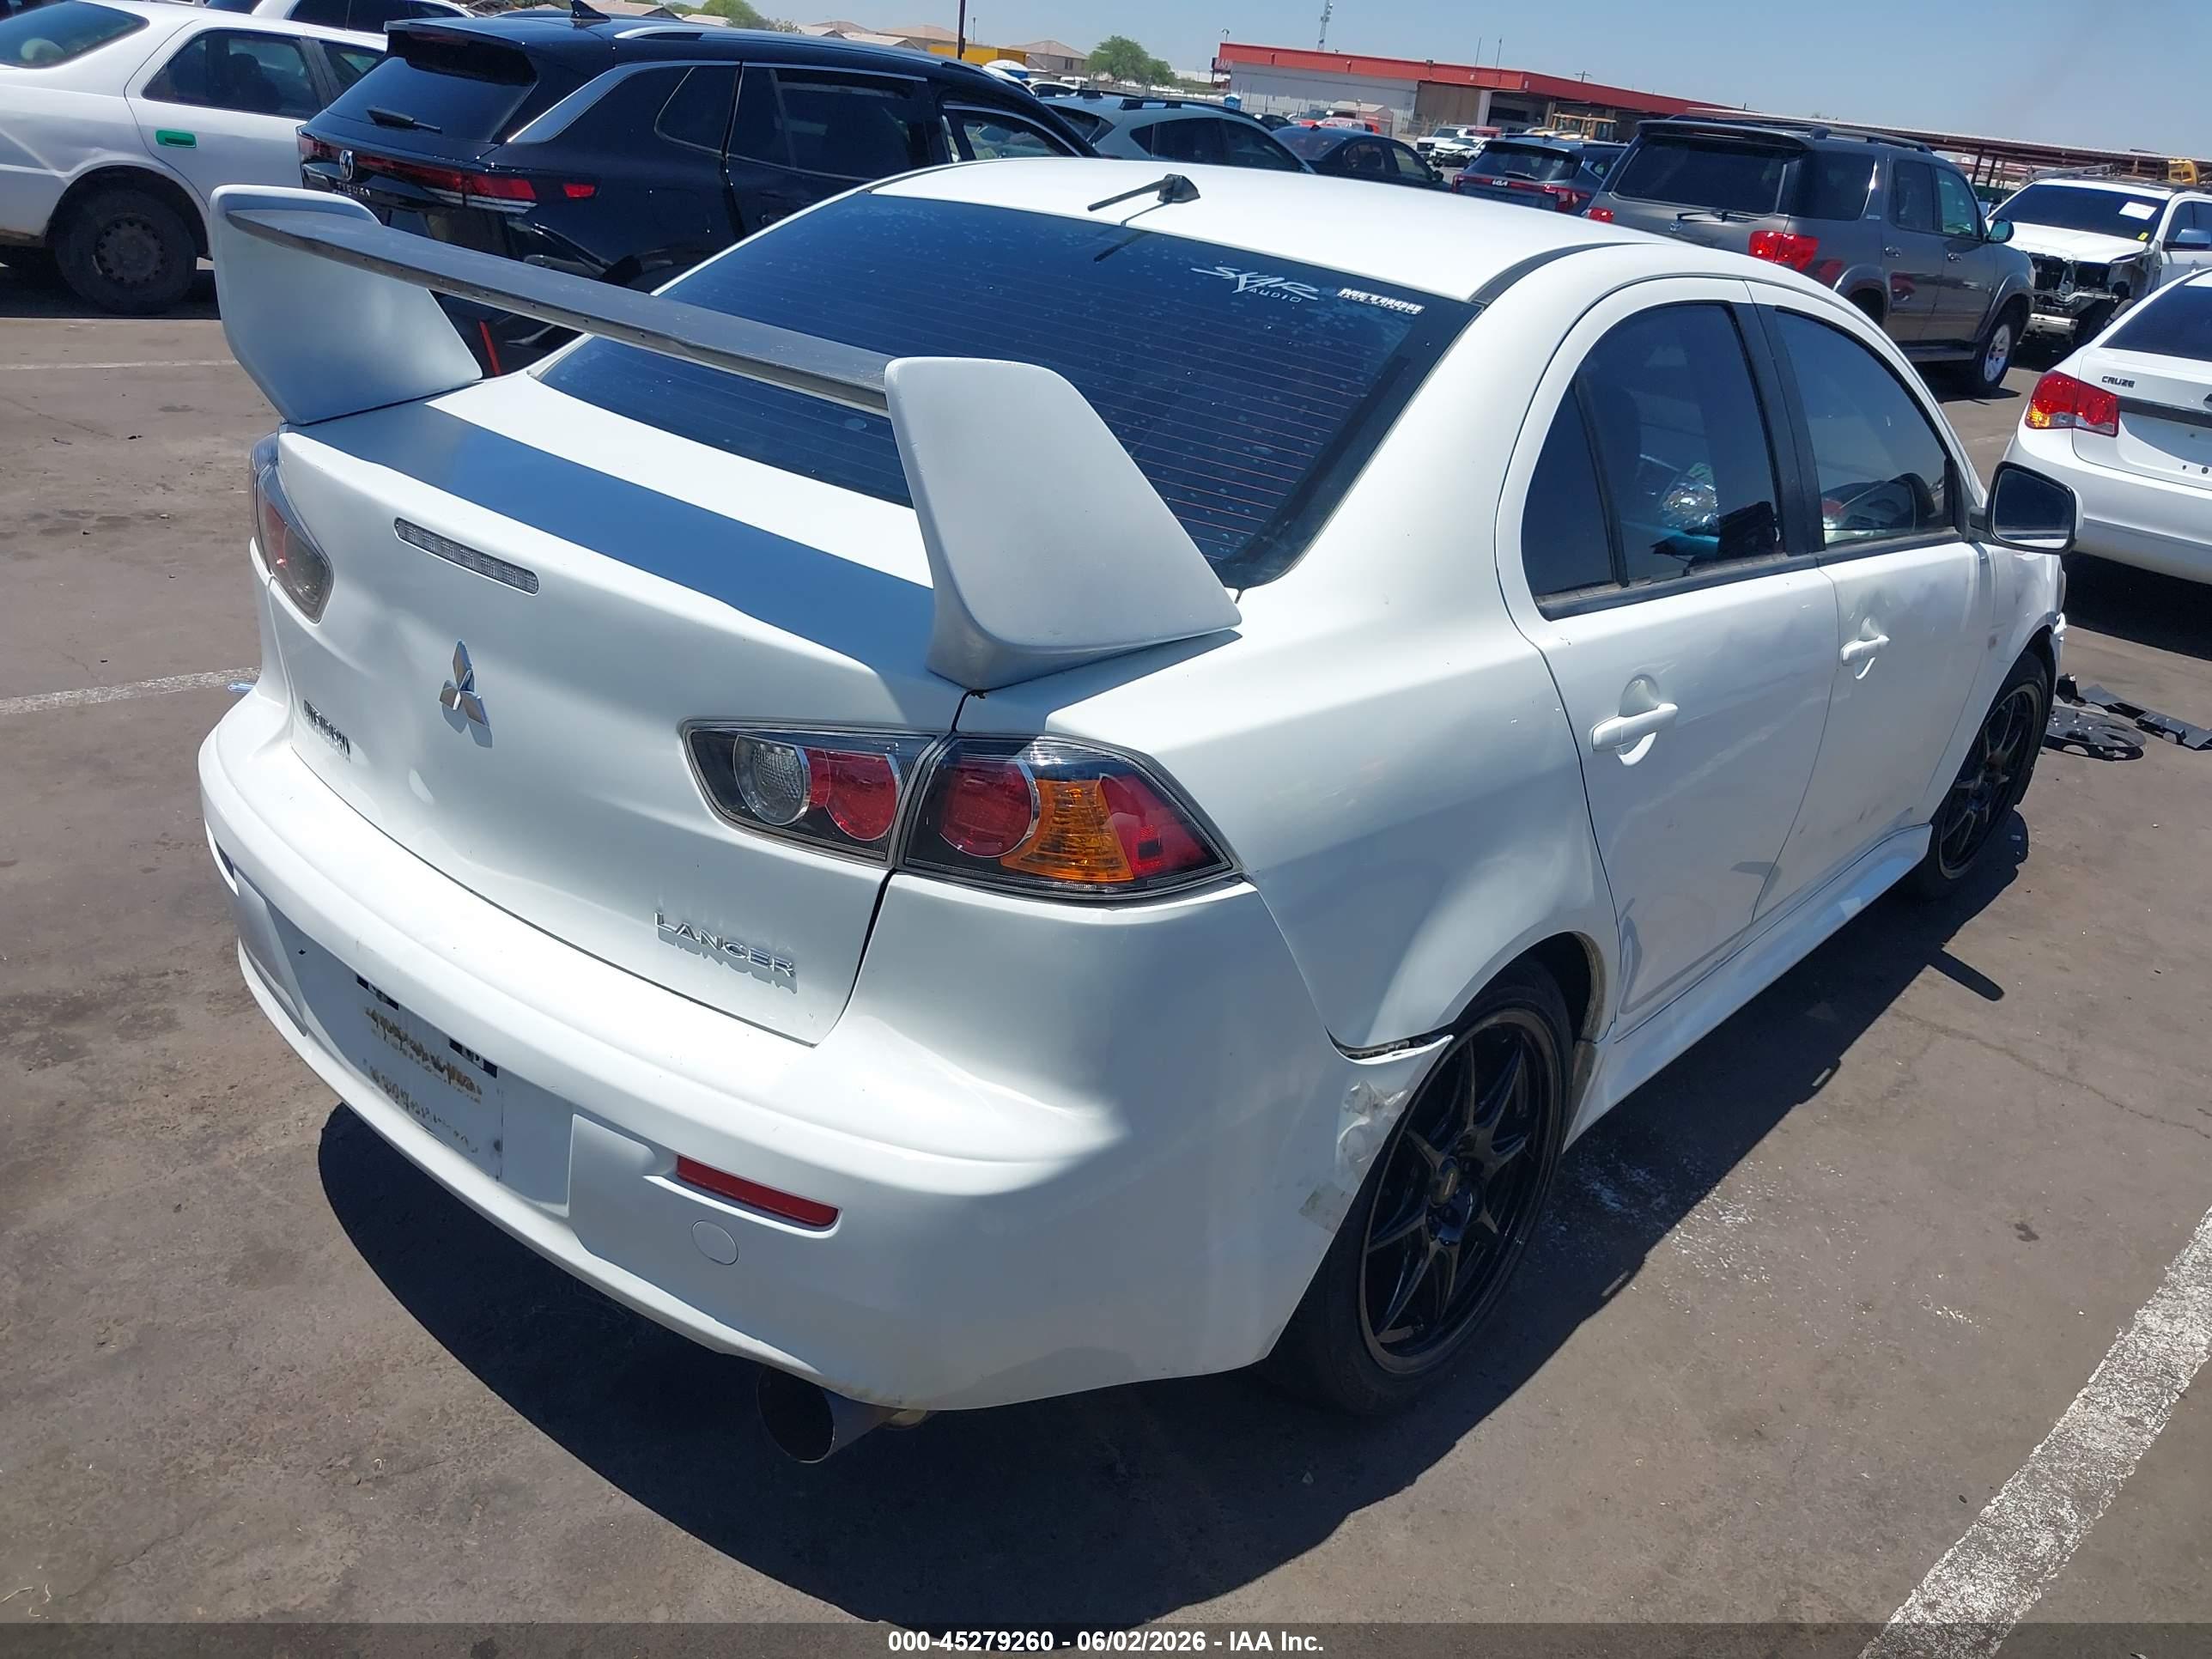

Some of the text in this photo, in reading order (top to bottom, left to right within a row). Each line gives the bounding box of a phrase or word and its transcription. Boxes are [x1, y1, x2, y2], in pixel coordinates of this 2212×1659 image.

[1249, 287, 1303, 303] AUDIO
[2101, 375, 2136, 388] CRUZE
[654, 911, 797, 978] LANCER
